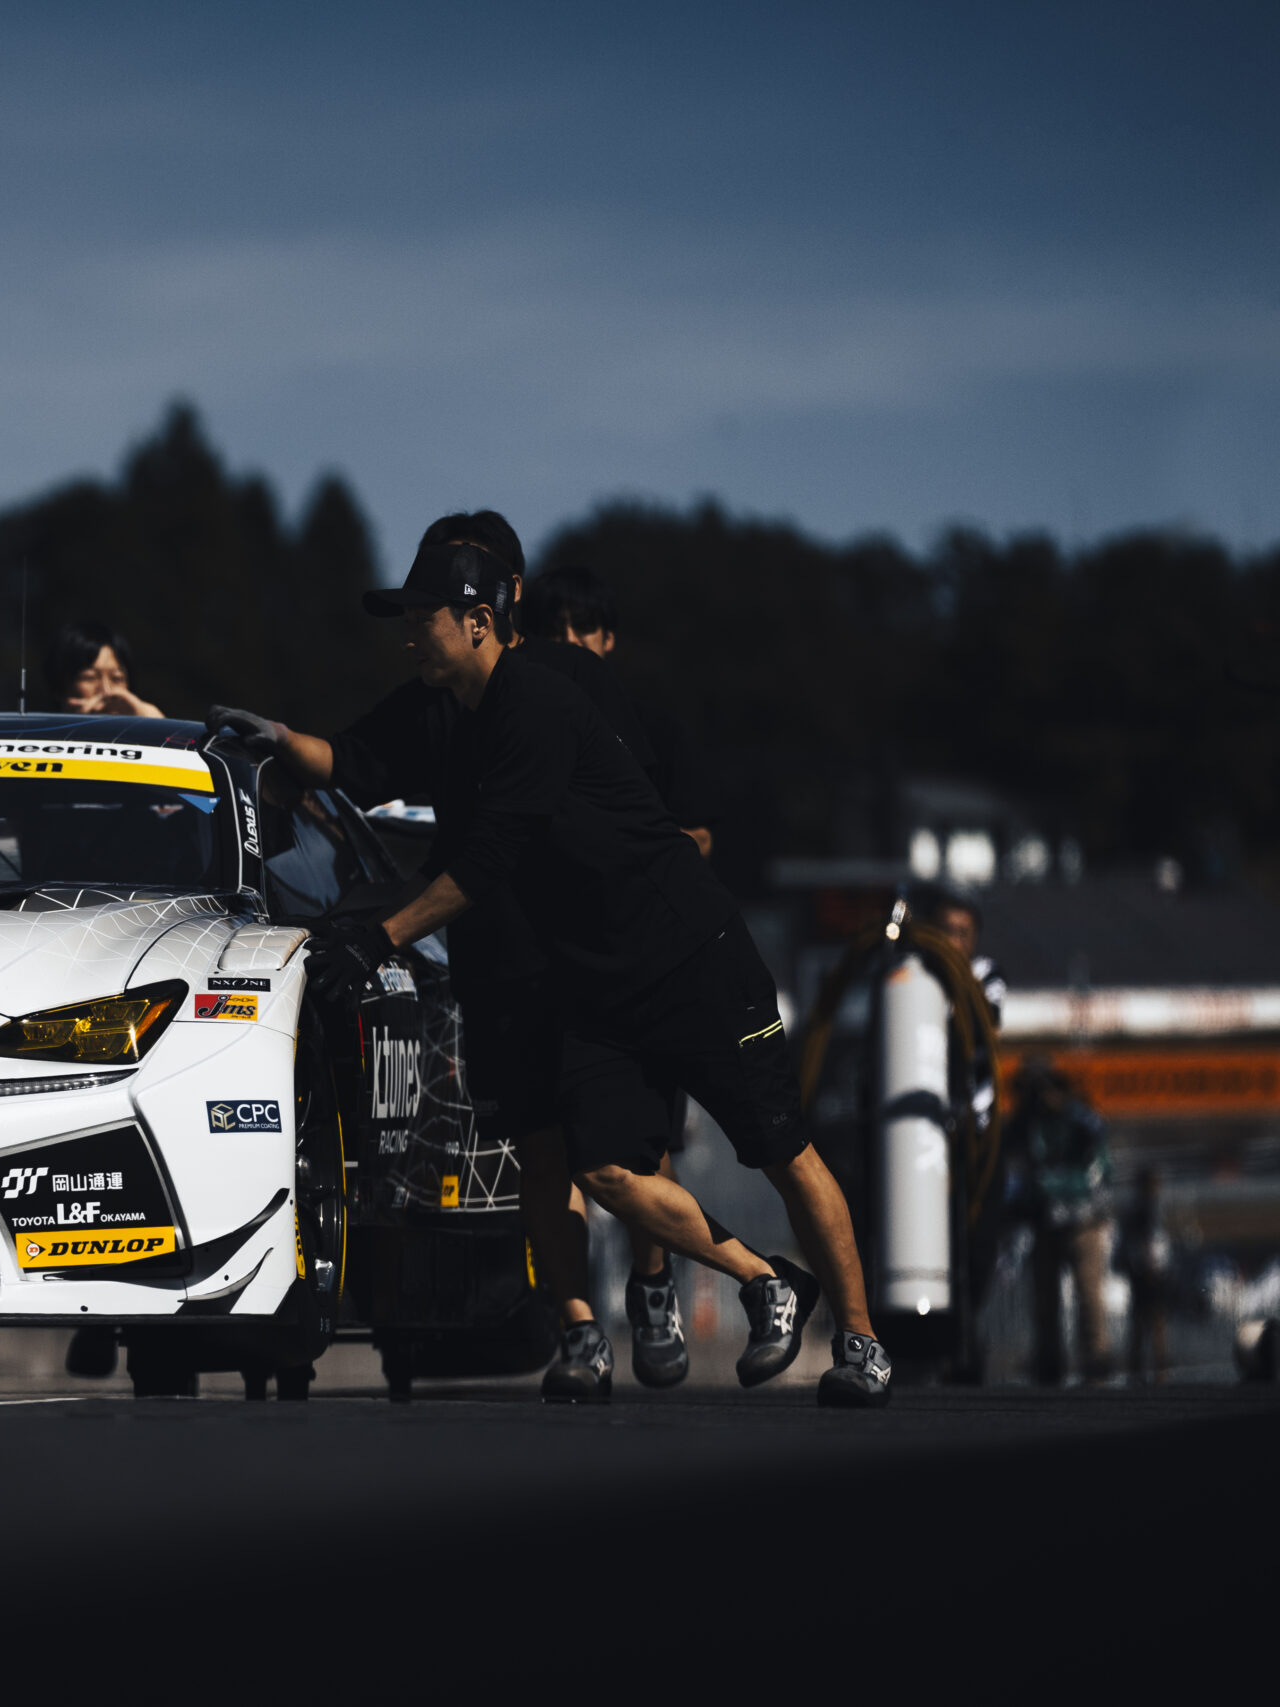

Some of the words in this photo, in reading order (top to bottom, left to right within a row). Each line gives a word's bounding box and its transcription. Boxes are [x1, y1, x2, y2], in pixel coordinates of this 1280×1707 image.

[236, 1103, 279, 1123] CPC
[378, 1129, 408, 1154] RACING
[52, 1172, 124, 1192] 岡山通運
[12, 1216, 56, 1227] TOYOTA
[56, 1202, 101, 1225] L&F
[100, 1212, 146, 1223] OKAYAMA
[48, 1238, 165, 1257] DUNLOP
